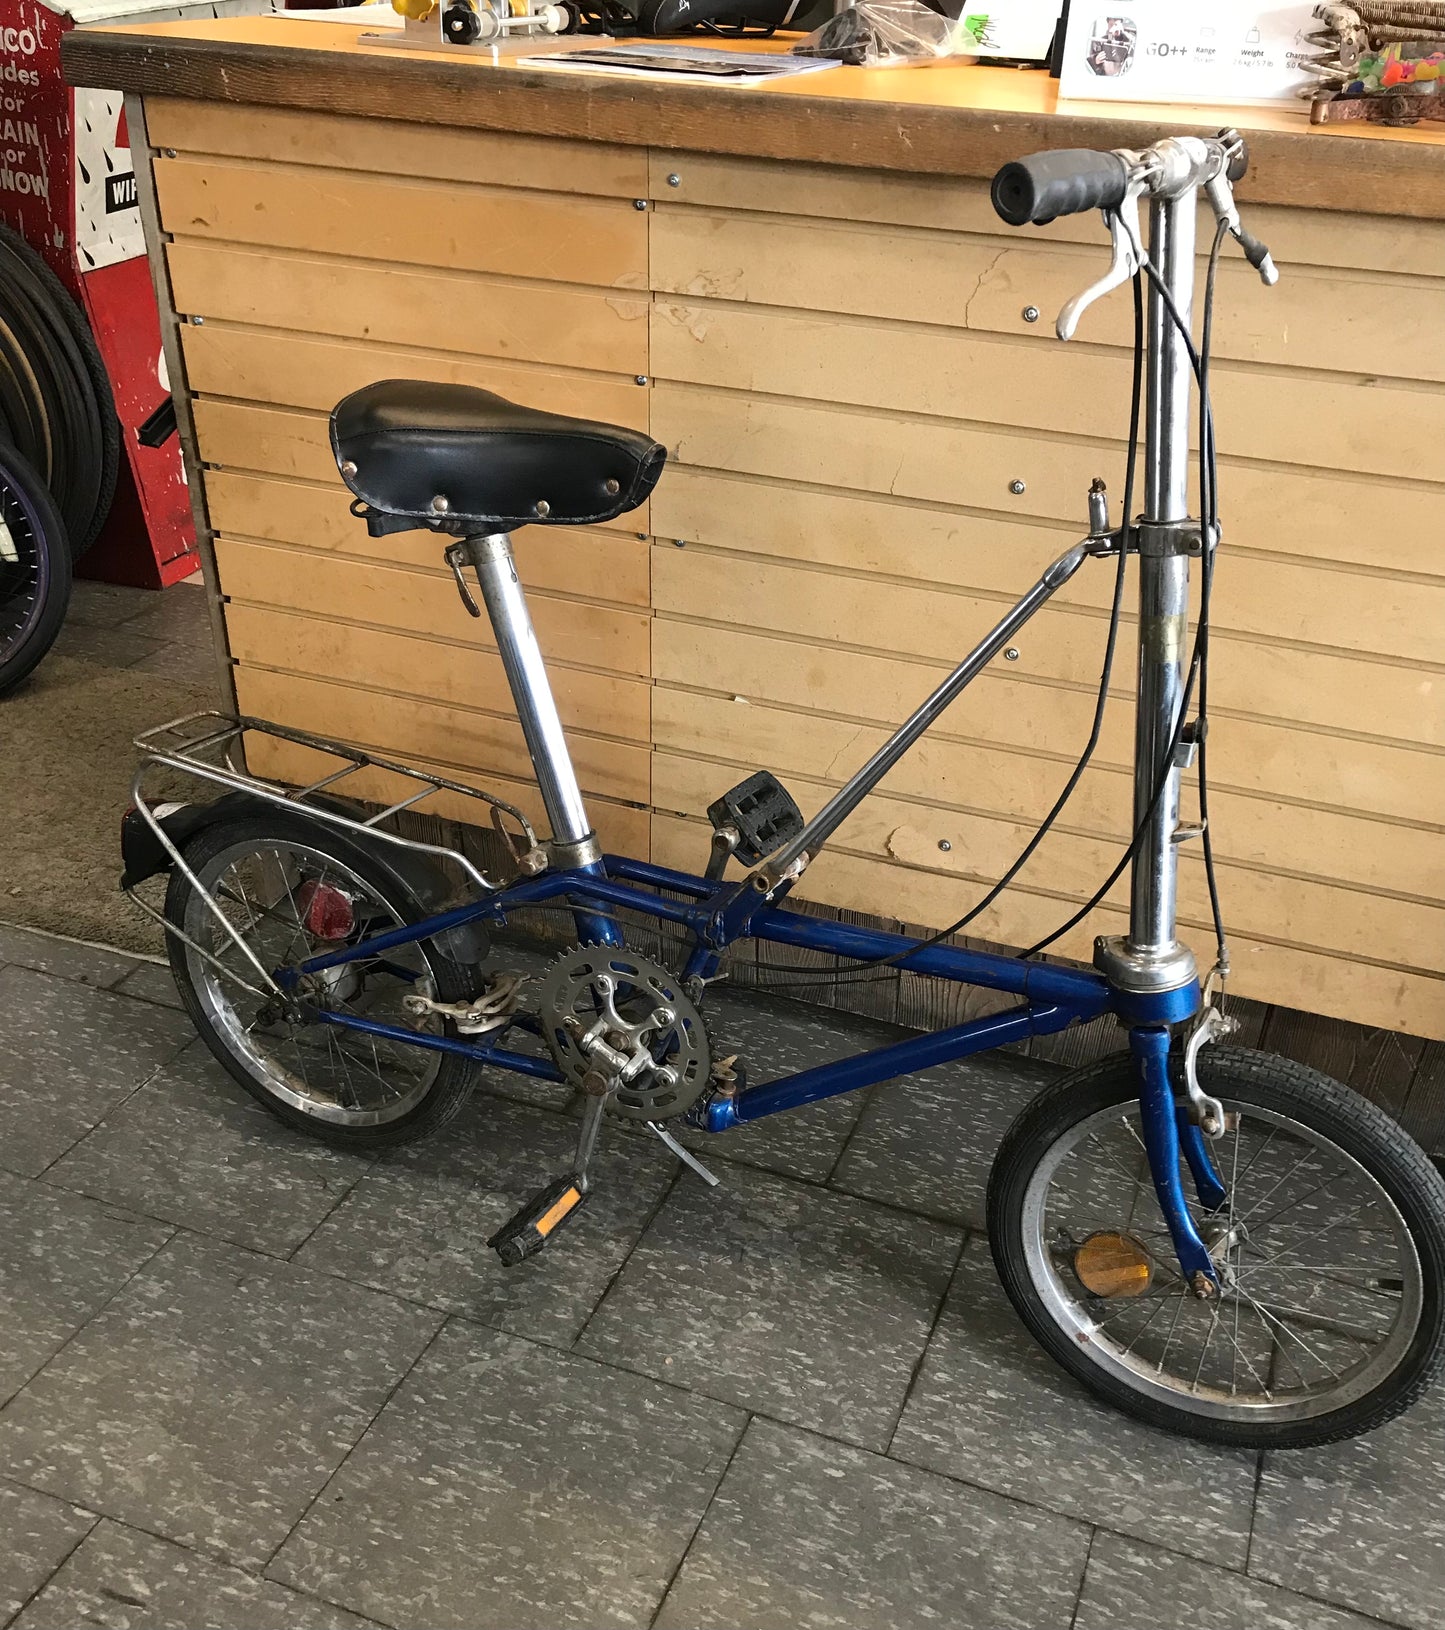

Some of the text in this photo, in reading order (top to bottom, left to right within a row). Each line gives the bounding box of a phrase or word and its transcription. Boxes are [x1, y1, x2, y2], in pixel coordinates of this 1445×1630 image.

[1195, 46, 1216, 55] Range
[1240, 49, 1264, 58] Weight
[0, 118, 40, 146] AIN
[0, 169, 49, 198] NOW
